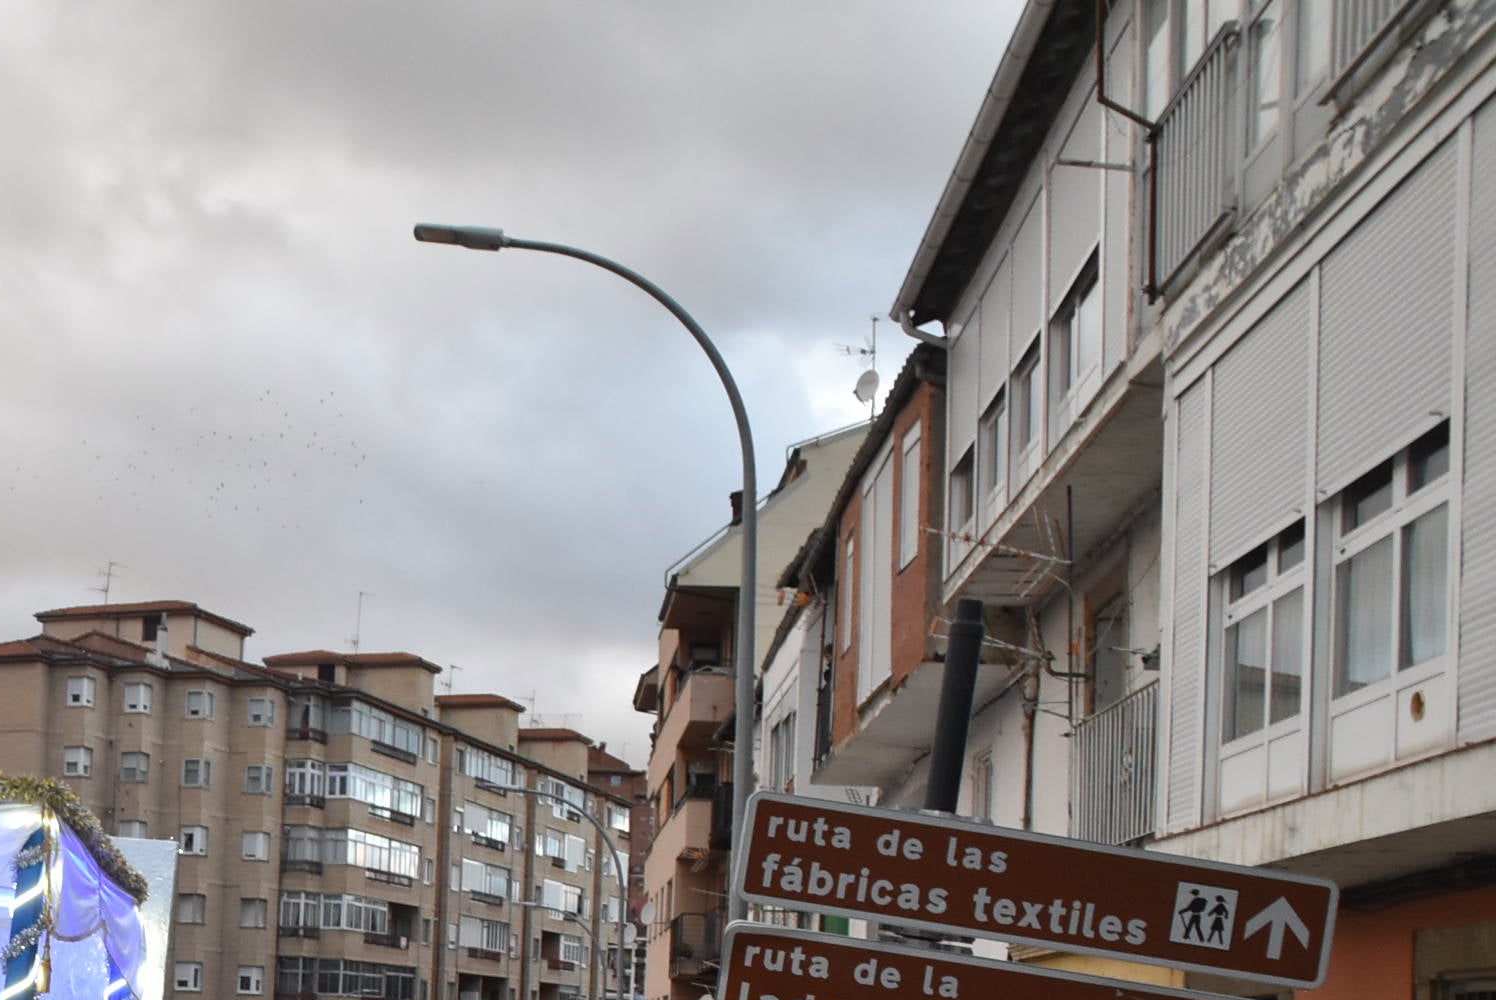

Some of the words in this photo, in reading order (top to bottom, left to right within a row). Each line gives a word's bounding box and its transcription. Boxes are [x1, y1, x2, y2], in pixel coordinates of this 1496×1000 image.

[767, 815, 851, 850] ruta
[876, 829, 924, 860] de
[946, 836, 1009, 873] las
[761, 852, 950, 914] fábricas
[973, 887, 1148, 945] textiles
[743, 945, 829, 980] ruta
[854, 958, 901, 989] de
[922, 965, 959, 999] la
